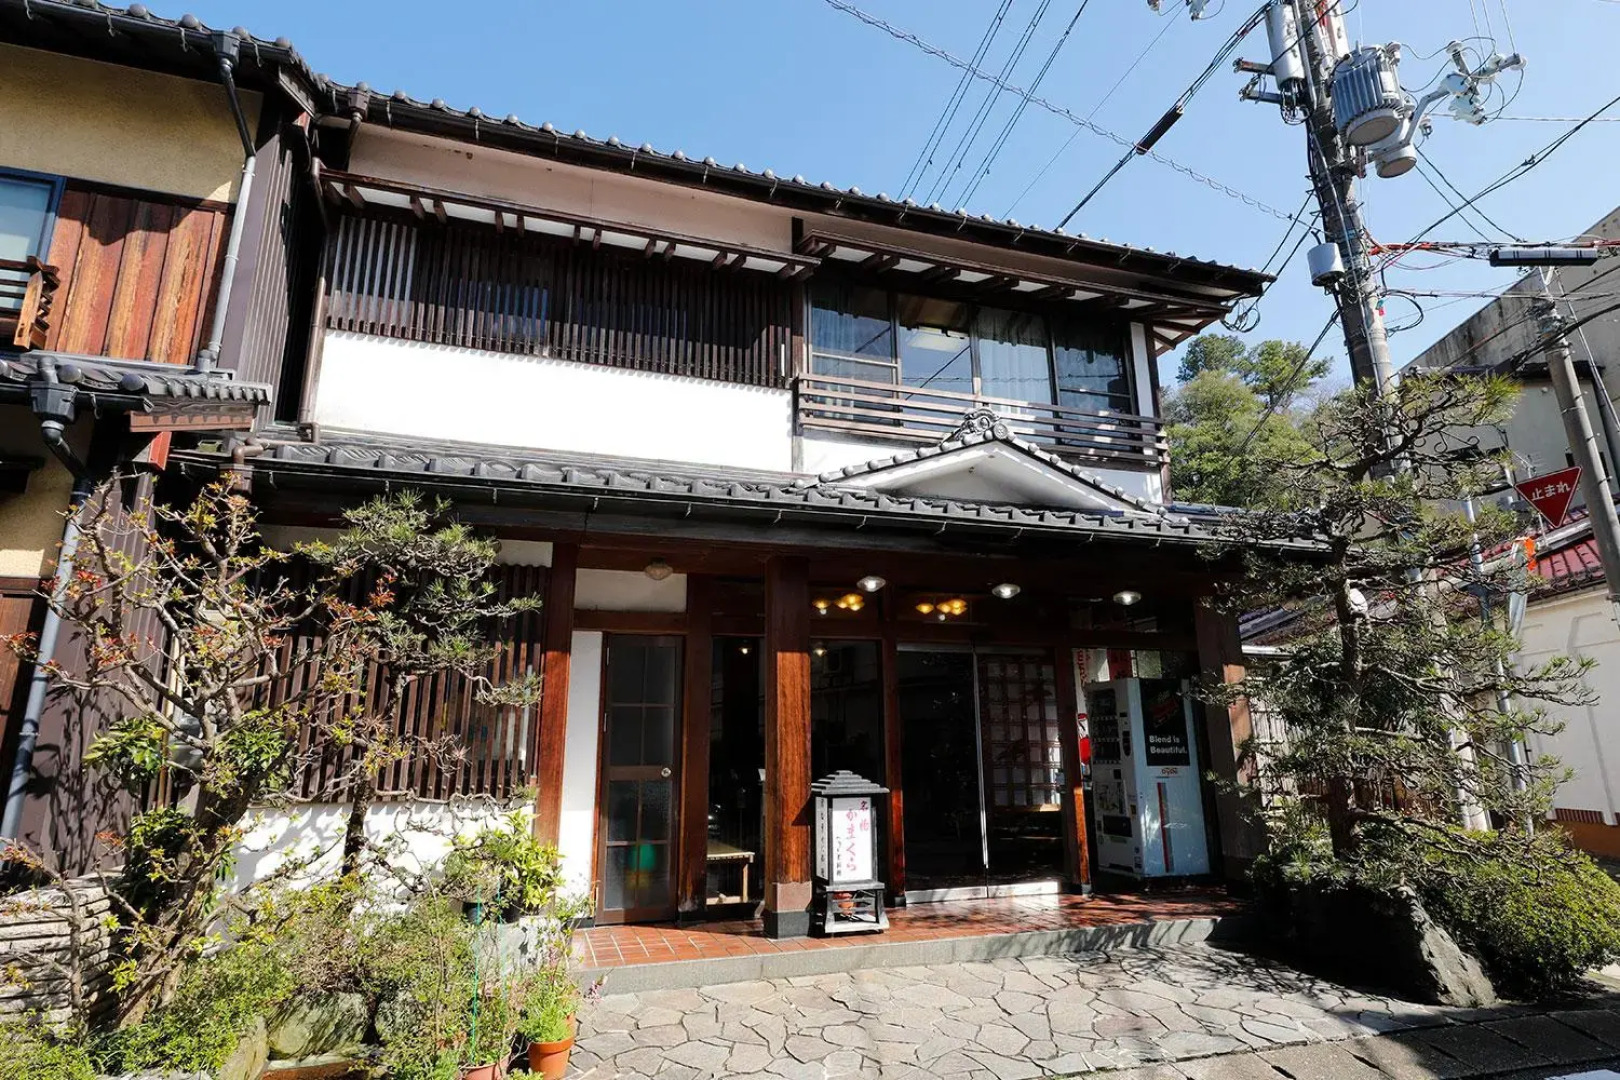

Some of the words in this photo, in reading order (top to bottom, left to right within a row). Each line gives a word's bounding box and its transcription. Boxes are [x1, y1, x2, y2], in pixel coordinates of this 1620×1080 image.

[1531, 481, 1571, 501] 止まれ
[1149, 735, 1171, 743] Blend
[1150, 746, 1187, 754] Beautiful.
